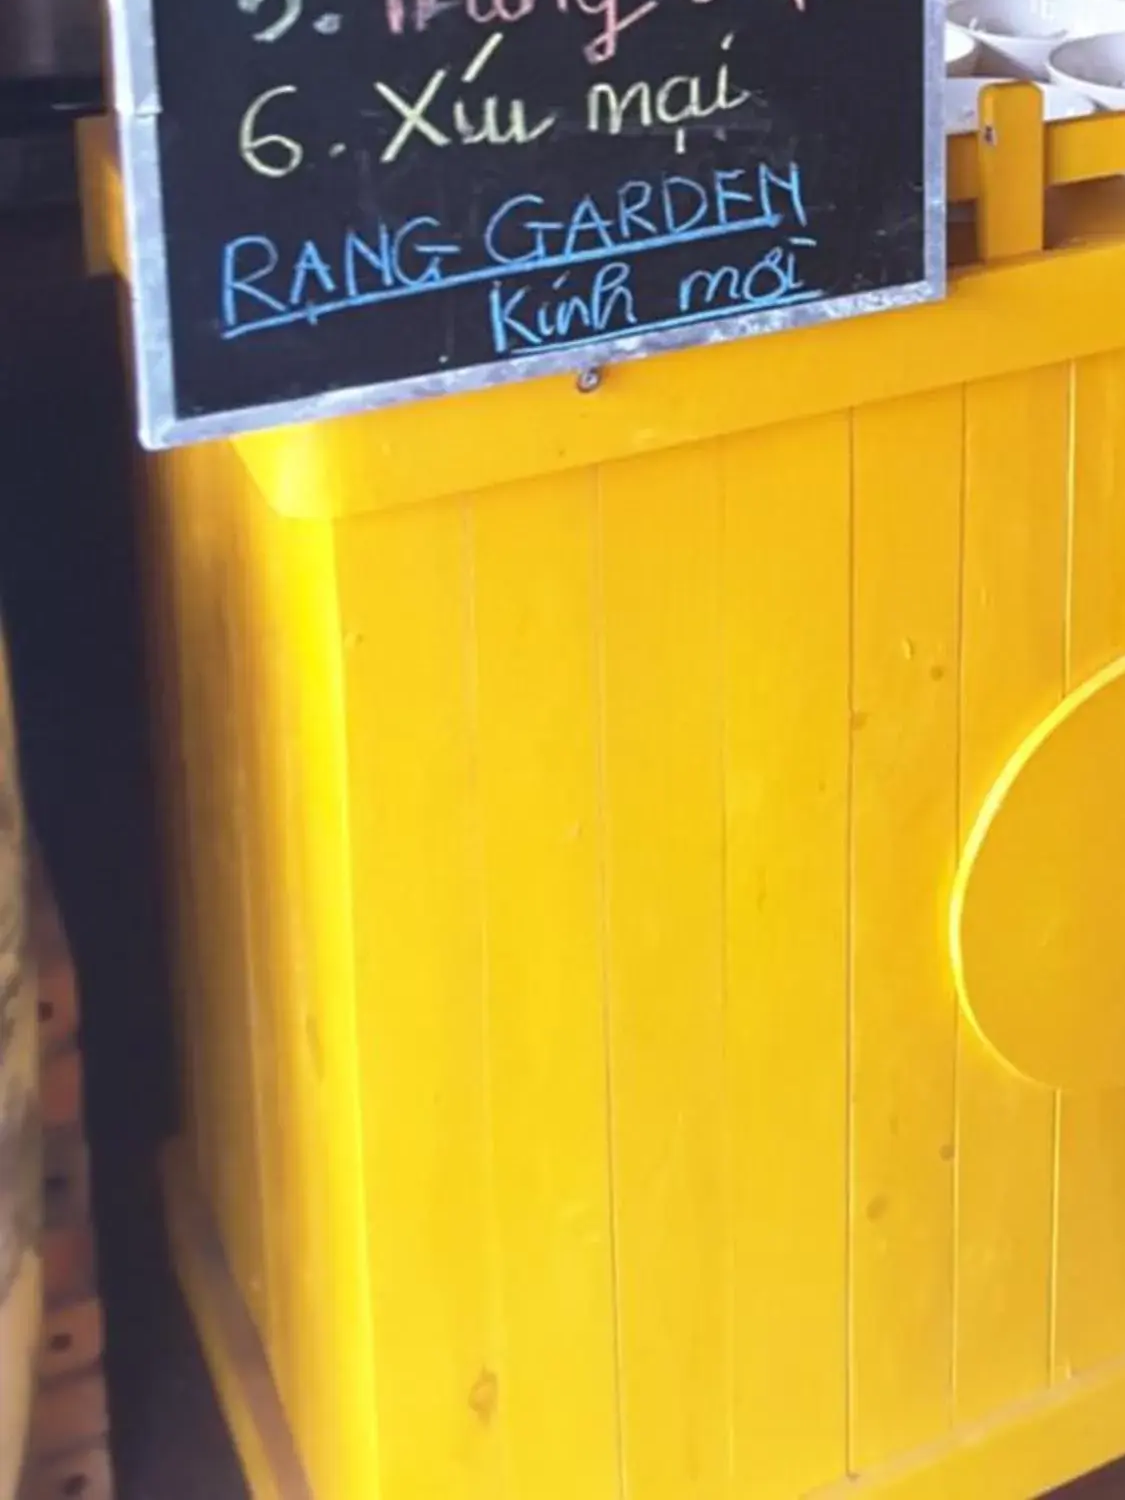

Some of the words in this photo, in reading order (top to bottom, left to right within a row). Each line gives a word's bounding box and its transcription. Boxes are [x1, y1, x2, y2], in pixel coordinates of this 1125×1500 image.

[239, 84, 347, 178] 6.
[373, 32, 557, 164] Xíu
[586, 32, 752, 155] mại
[220, 215, 461, 330] RANG
[483, 161, 809, 266] GARDEN
